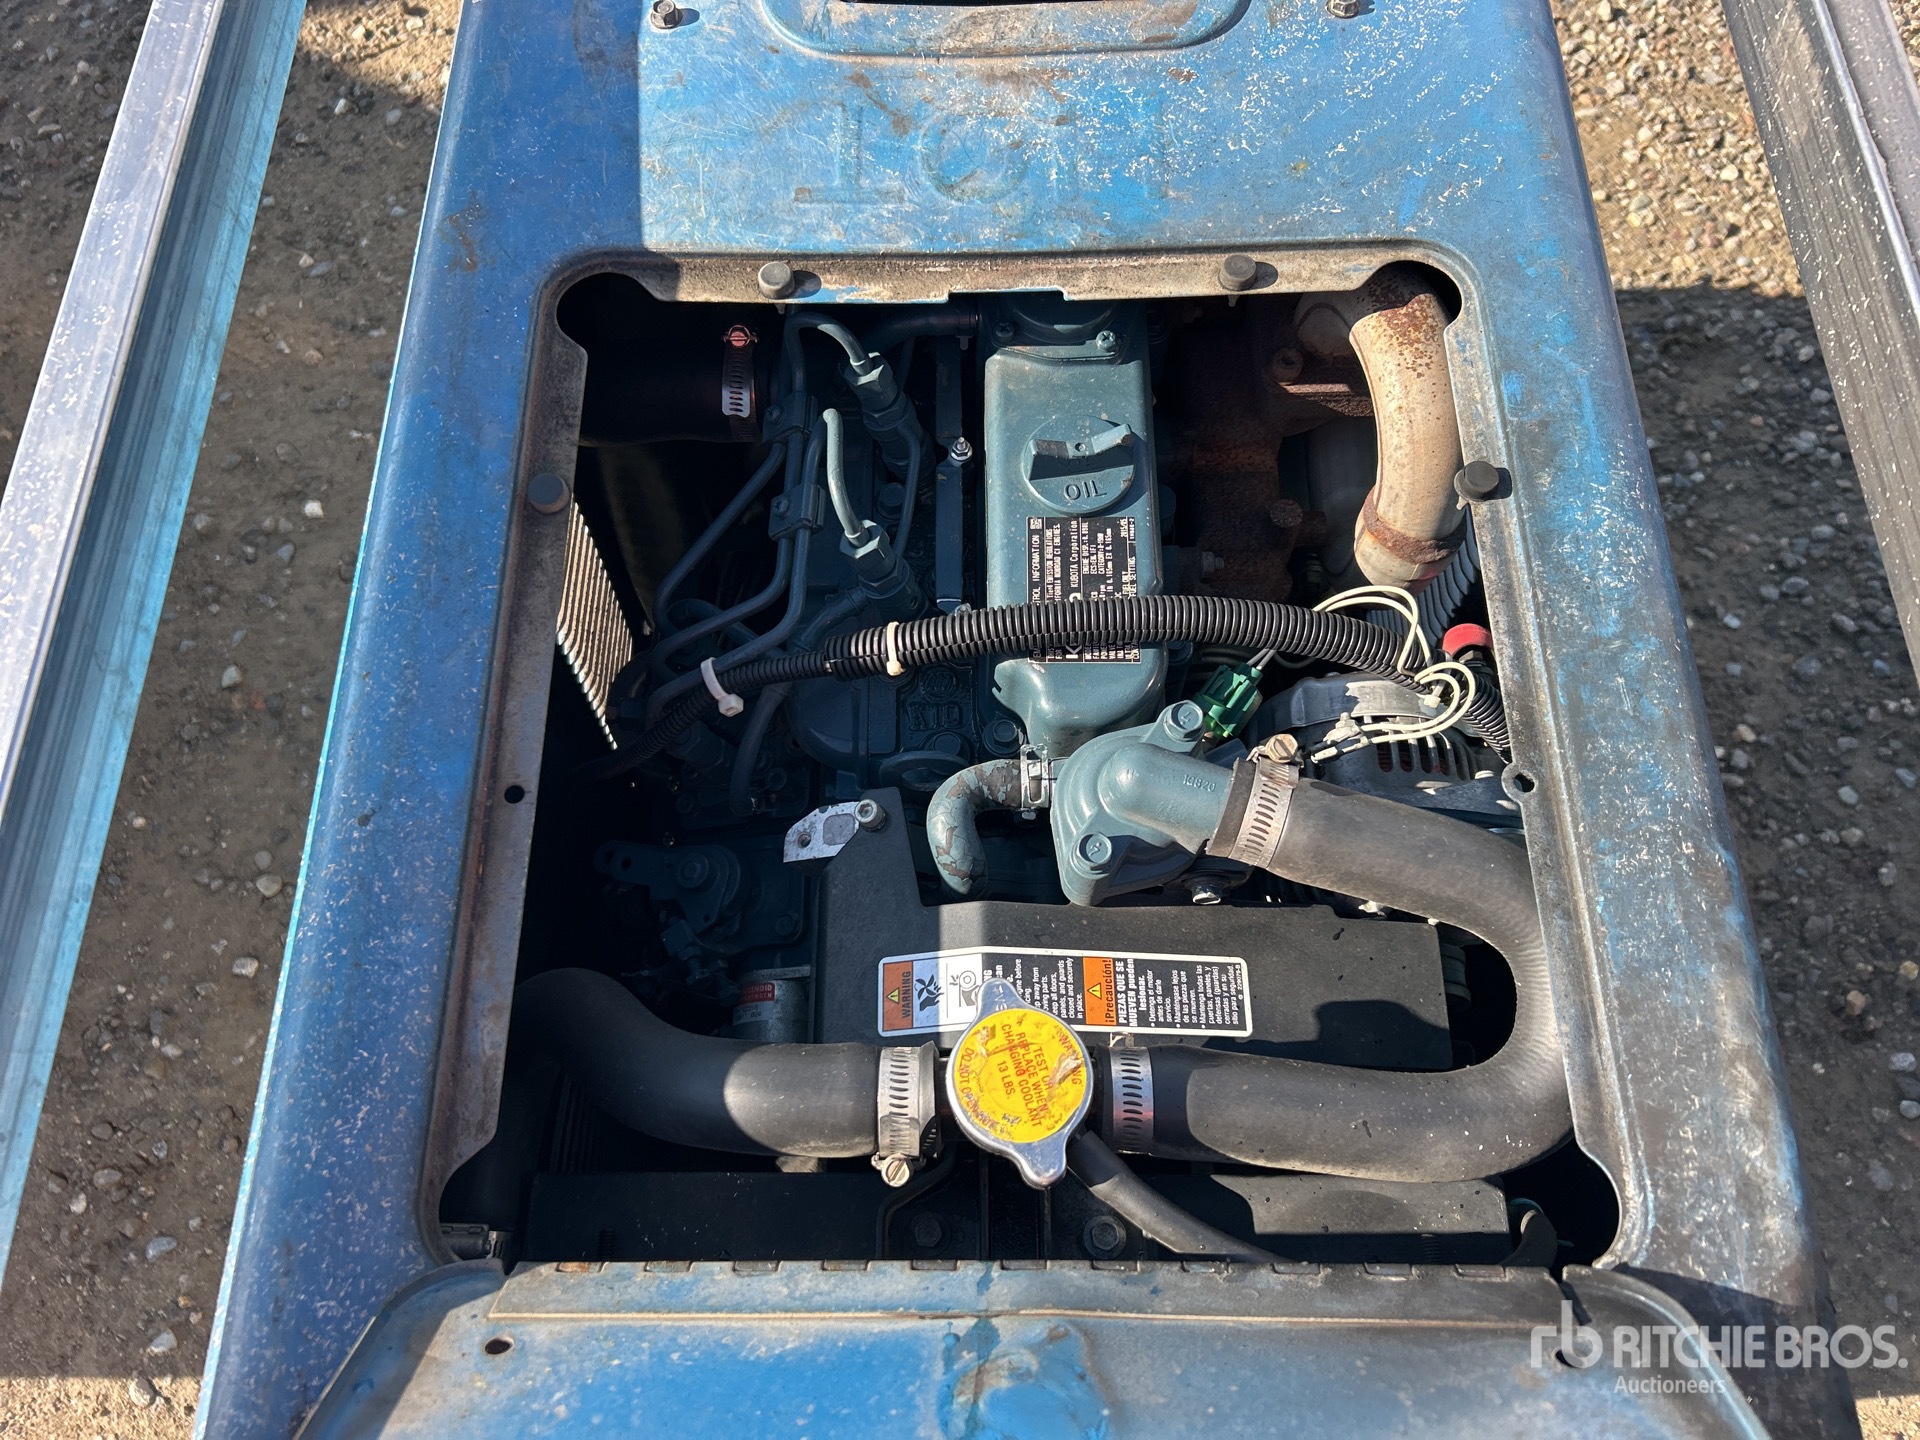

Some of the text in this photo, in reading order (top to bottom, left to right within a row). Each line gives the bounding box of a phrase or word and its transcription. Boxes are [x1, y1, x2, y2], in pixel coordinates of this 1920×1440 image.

[1063, 480, 1107, 501] OIL
[1069, 520, 1079, 562] Corporation
[1032, 535, 1040, 582] INFORMATION
[1070, 564, 1078, 588] KUBOTA
[1058, 960, 1066, 981] guards
[1172, 970, 1180, 984] lejos
[1212, 966, 1221, 995] (guardas)
[1227, 964, 1236, 996] seguridad.
[902, 971, 912, 1018] WARNING
[1041, 975, 1049, 993] parts.
[1102, 960, 1114, 1022] ¡Precaución!
[1116, 961, 1127, 1024] PIEZAS QUE SE
[1126, 958, 1138, 1026] MUEVEN pueden
[1138, 975, 1146, 1010] lesionar.
[1181, 984, 1189, 1004] piezas
[1204, 972, 1214, 998] paneles,
[1222, 983, 1228, 991] en
[1059, 996, 1068, 1018] panels,
[1076, 992, 1084, 1012] place.
[1156, 996, 1162, 1004] de
[1164, 996, 1172, 1022] servicio.
[1207, 998, 1216, 1024] puertas,
[1222, 998, 1230, 1024] cerradas
[1230, 996, 1238, 1010] para
[1182, 1014, 1190, 1023] de
[1192, 1016, 1198, 1024] se
[962, 1048, 974, 1061] DO
[1032, 1046, 1048, 1073] TEST
[997, 1060, 1016, 1098] 13 LBS.
[1001, 1023, 1026, 1076] CHANGING
[1018, 1079, 1042, 1128] COOLANT
[1015, 1032, 1049, 1112] REPLACE WHEN
